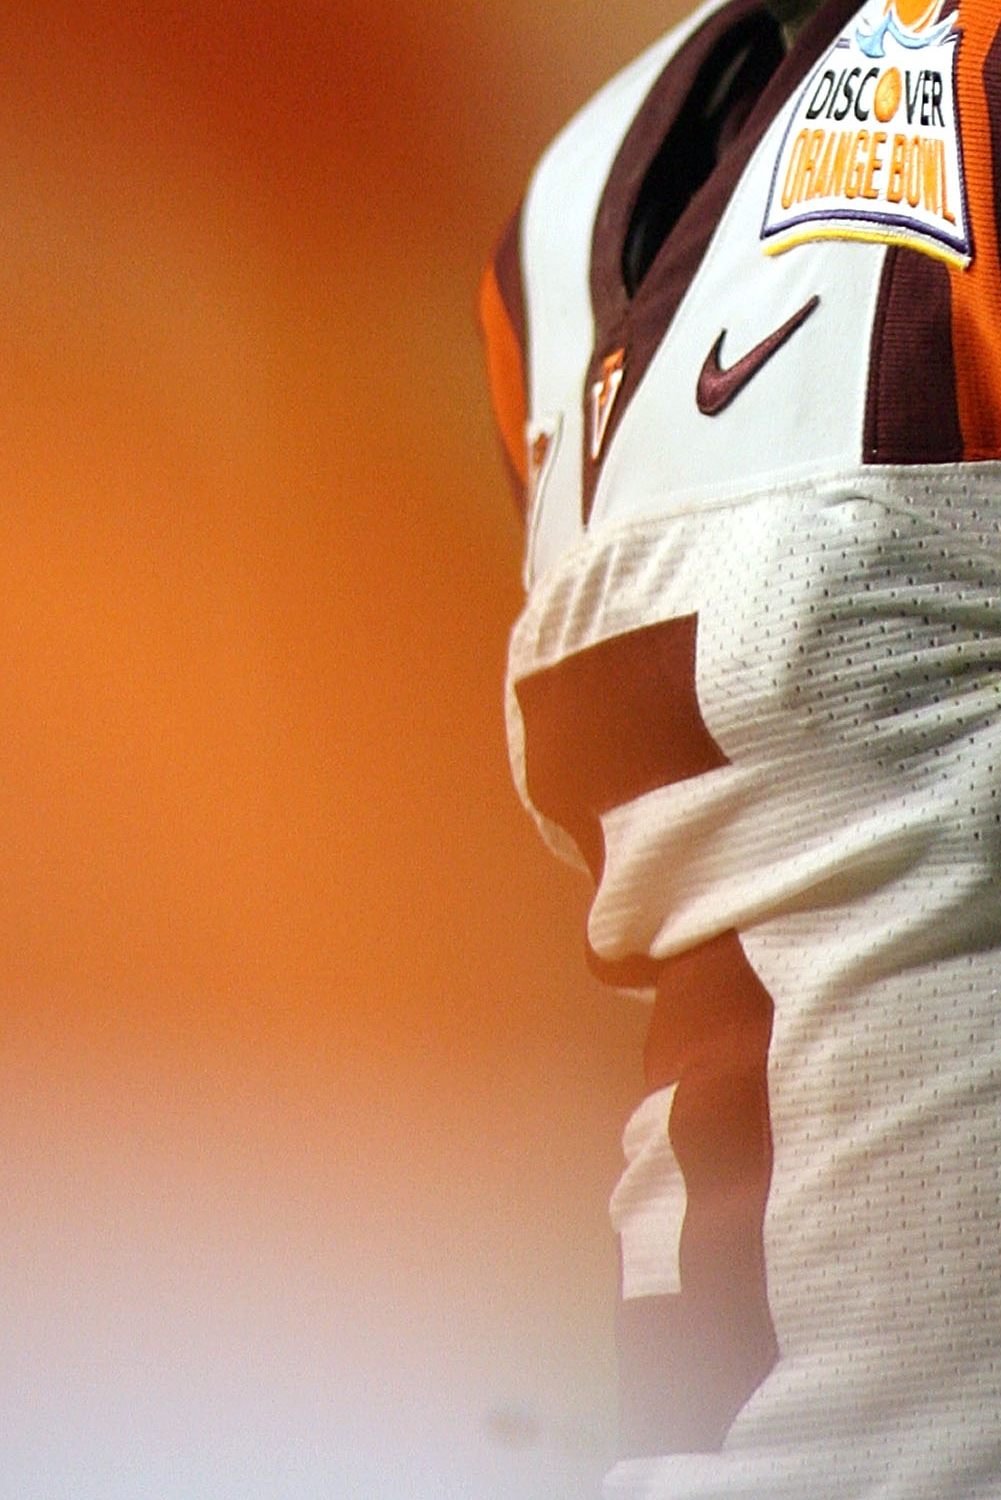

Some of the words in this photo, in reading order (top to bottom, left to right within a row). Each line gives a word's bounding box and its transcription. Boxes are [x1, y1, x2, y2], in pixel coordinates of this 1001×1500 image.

[806, 66, 945, 127] DISCOVER
[782, 128, 886, 210] ORANGE
[887, 133, 956, 226] BOWL
